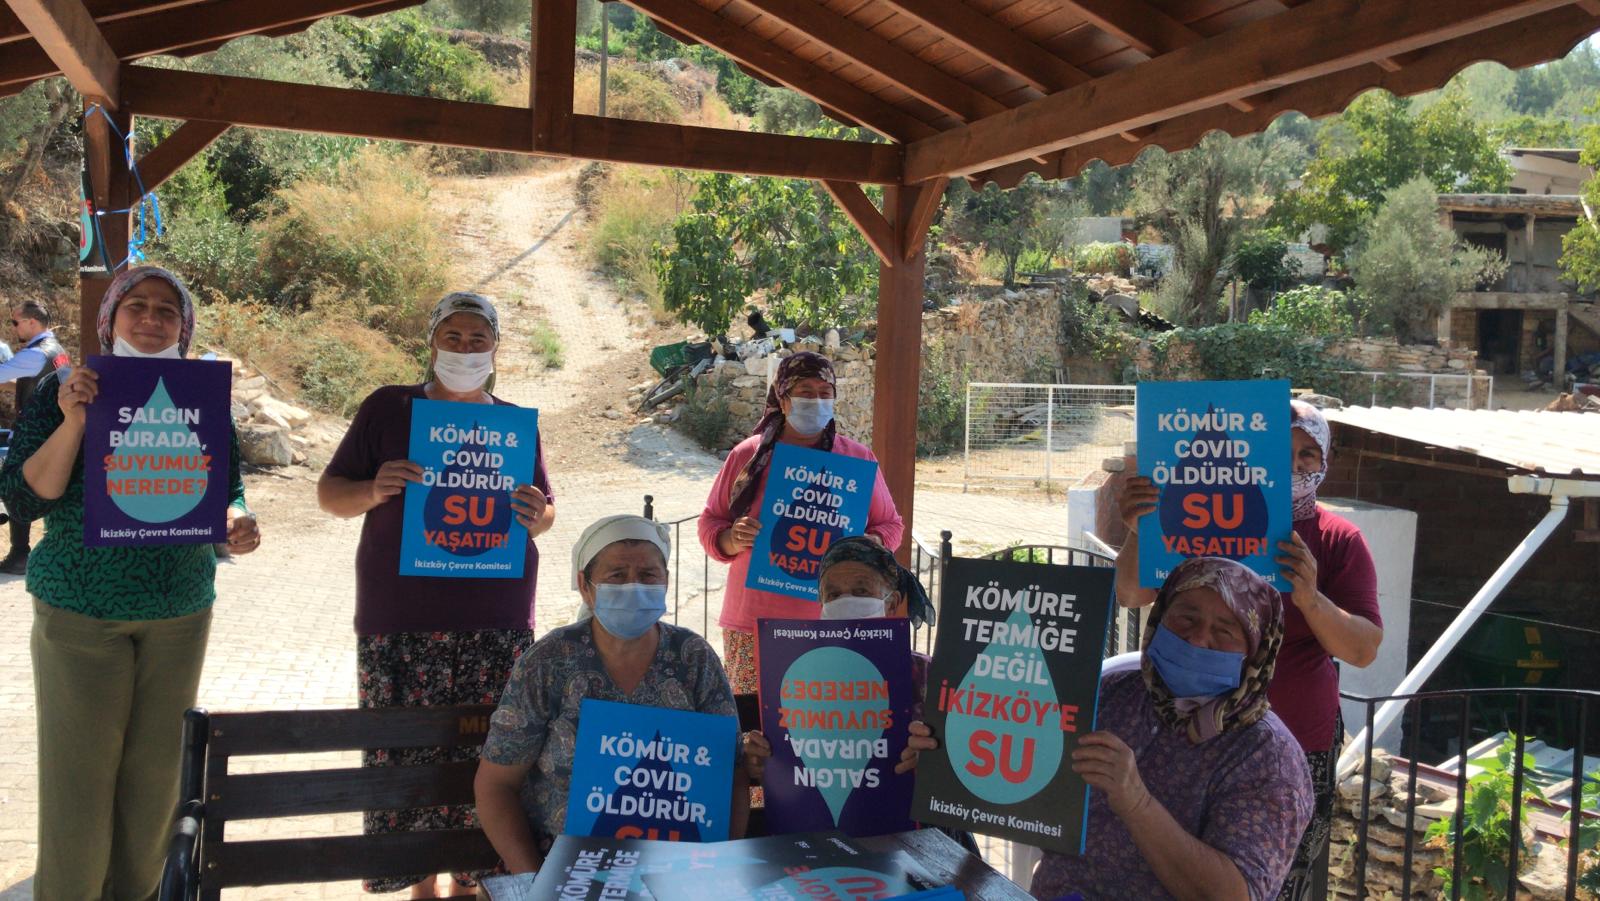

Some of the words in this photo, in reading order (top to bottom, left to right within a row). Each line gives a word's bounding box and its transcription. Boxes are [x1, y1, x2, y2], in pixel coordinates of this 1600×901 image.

[118, 406, 200, 424] SALGIN
[1158, 408, 1245, 432] KÖMÜR
[1250, 412, 1267, 432] &
[110, 430, 207, 450] BURADA,
[430, 423, 502, 446] KÖMÜR
[504, 432, 519, 448] &
[442, 450, 504, 468] COVID
[1174, 440, 1250, 458] COVID
[104, 454, 212, 472] SUYUMUZ
[1152, 461, 1274, 488] ÖLDÜRÜR,
[106, 478, 207, 496] NEREDE?
[422, 466, 518, 491] ÖLDÜRÜR
[784, 466, 844, 490] KÖMÜR
[846, 479, 858, 494] &
[792, 487, 843, 508] COVID
[442, 494, 495, 526] SU
[772, 498, 853, 532] ÖLDÜRÜR,
[1182, 493, 1244, 530] SU
[100, 528, 136, 538] İkizköy
[138, 529, 168, 540] Çevre
[170, 526, 212, 536] Komitesi
[424, 529, 508, 552] YAŞATIR!
[785, 525, 832, 556] SU
[414, 558, 447, 570] İkizköy
[448, 561, 474, 572] Çevre
[475, 560, 512, 570] Komitesi
[768, 552, 820, 575] YAŞAT
[785, 582, 807, 592] Çevre
[964, 581, 1082, 622] KÖMÜRE,
[774, 628, 817, 640] Komitesi
[819, 628, 850, 640] Çevre
[853, 628, 892, 640] İkizköy
[962, 618, 1078, 654] TERMİĞE
[974, 652, 1048, 686] DEĞİL
[782, 680, 889, 702] NEREDE?
[938, 680, 1079, 733] İKİZKÖY'E
[459, 715, 488, 736] Mi
[778, 708, 893, 730] SUYUMUZ
[600, 732, 690, 764] KÖMÜR
[694, 746, 712, 767] &
[784, 734, 888, 759] BURADA,
[964, 730, 1036, 784] SU
[614, 765, 692, 792] COVID
[794, 766, 880, 788] SALGIN
[586, 786, 712, 828] ÖLDÜRÜR,
[930, 796, 970, 820] İkizköy
[972, 808, 1005, 826] Çevre
[1008, 816, 1062, 837] Komitesi
